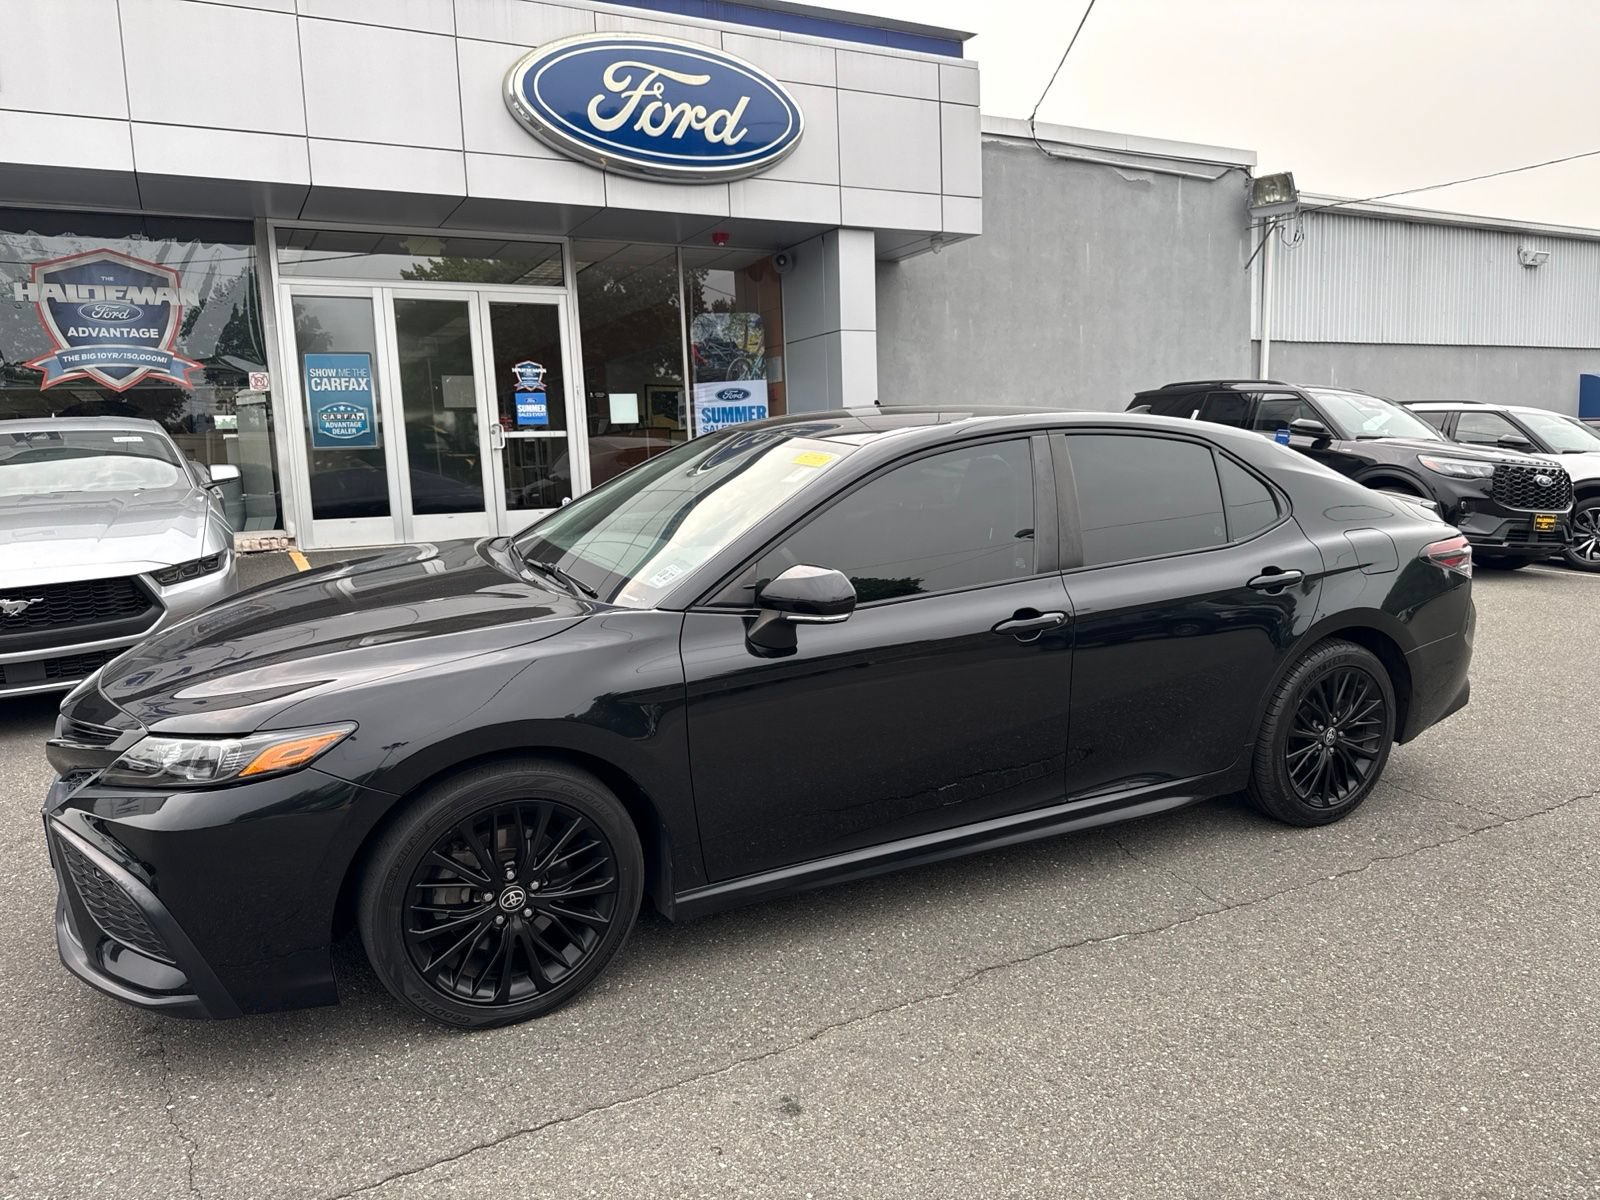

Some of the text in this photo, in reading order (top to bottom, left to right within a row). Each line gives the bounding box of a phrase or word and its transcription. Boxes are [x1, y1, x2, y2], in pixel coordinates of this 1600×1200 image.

[587, 60, 750, 146] Ford
[91, 303, 130, 320] Ford
[67, 327, 159, 339] ADVANTAGE
[63, 355, 81, 363] THE
[82, 353, 97, 361] BIG
[310, 368, 368, 377] SHOW ME THE
[312, 379, 369, 391] CARFAX
[722, 390, 744, 400] Ford
[518, 405, 546, 413] SUMMER
[702, 406, 766, 423] SUMMER
